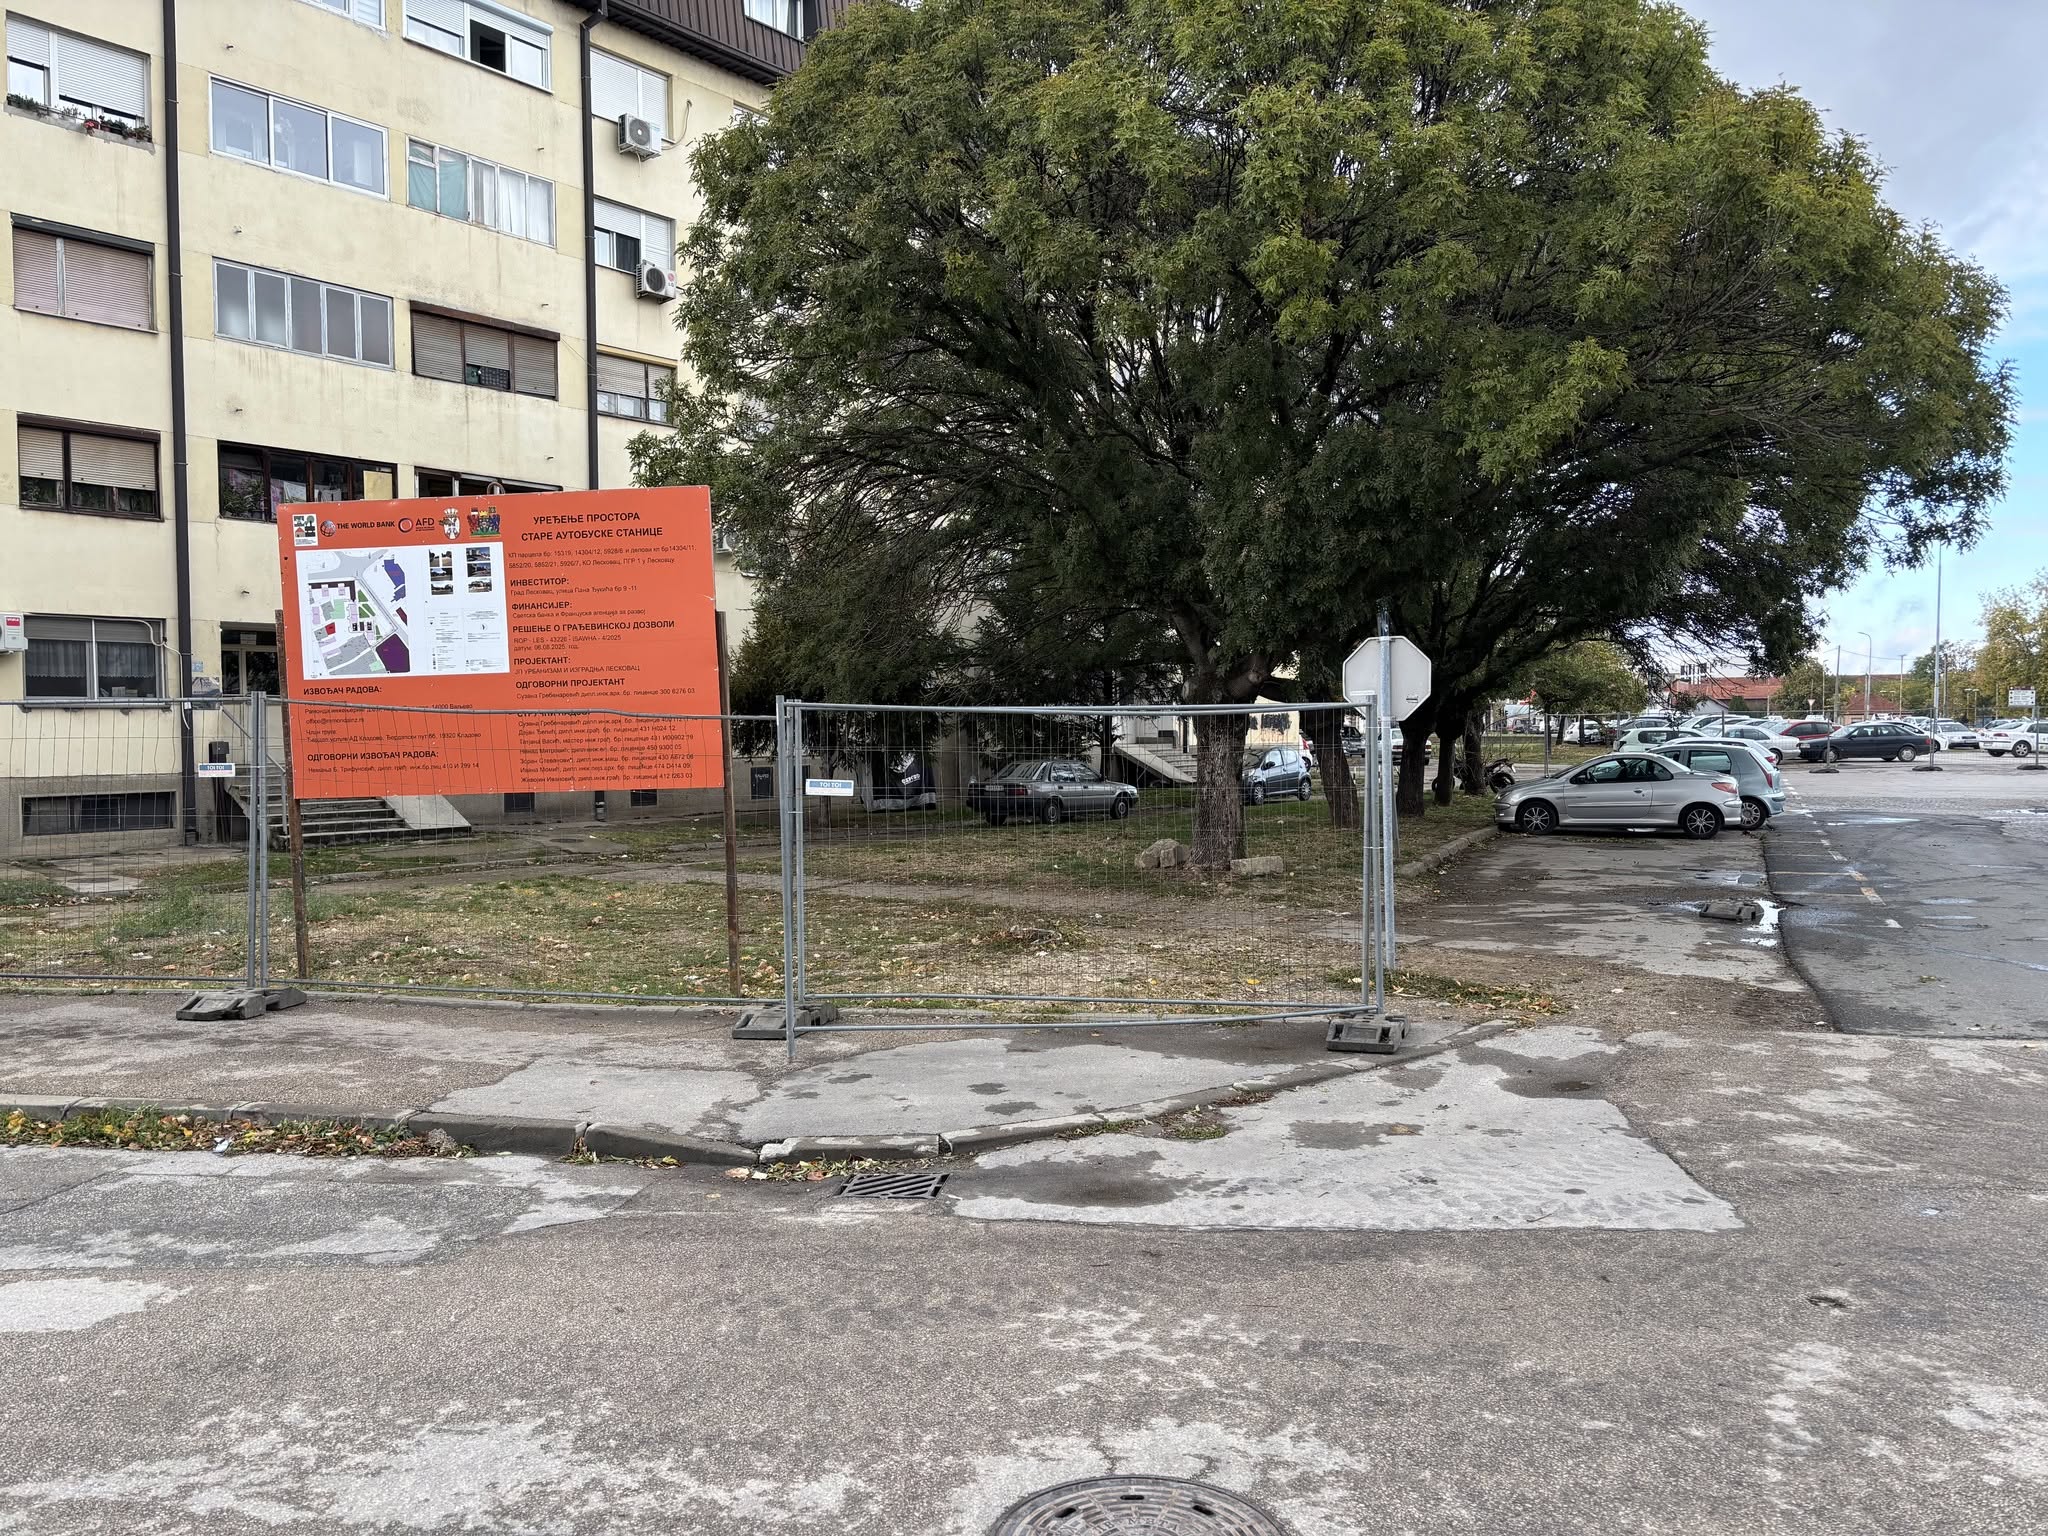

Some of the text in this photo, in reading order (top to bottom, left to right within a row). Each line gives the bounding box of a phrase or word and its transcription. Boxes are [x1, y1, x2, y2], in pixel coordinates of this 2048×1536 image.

[416, 518, 434, 526] AFD
[533, 512, 640, 525] УРЕЂЕЊЕ ПРОСТОРА
[336, 522, 349, 530] THE
[521, 527, 663, 541] СТАРЕ АУТОБУСКЕ СТАНИЦЕ
[510, 578, 569, 587] ИНВЕСТИТОР:
[512, 602, 572, 610] ФИНАНСИЈЕР:
[513, 621, 675, 633] РЕШЕЊЕ О ГРАЂЕВИНСКОЈ ДОЗВОЛИ
[514, 657, 571, 665] ПРОЈЕКТАНТ:
[516, 678, 625, 689] ОДГОВОРНИ ПРОЈЕКТАНТ
[303, 686, 382, 696] ИЗВОЂАЧ РАДОВА:
[307, 750, 439, 761] ОДГОВОРНИ ИЗВОЂАЧ РАДОВА:
